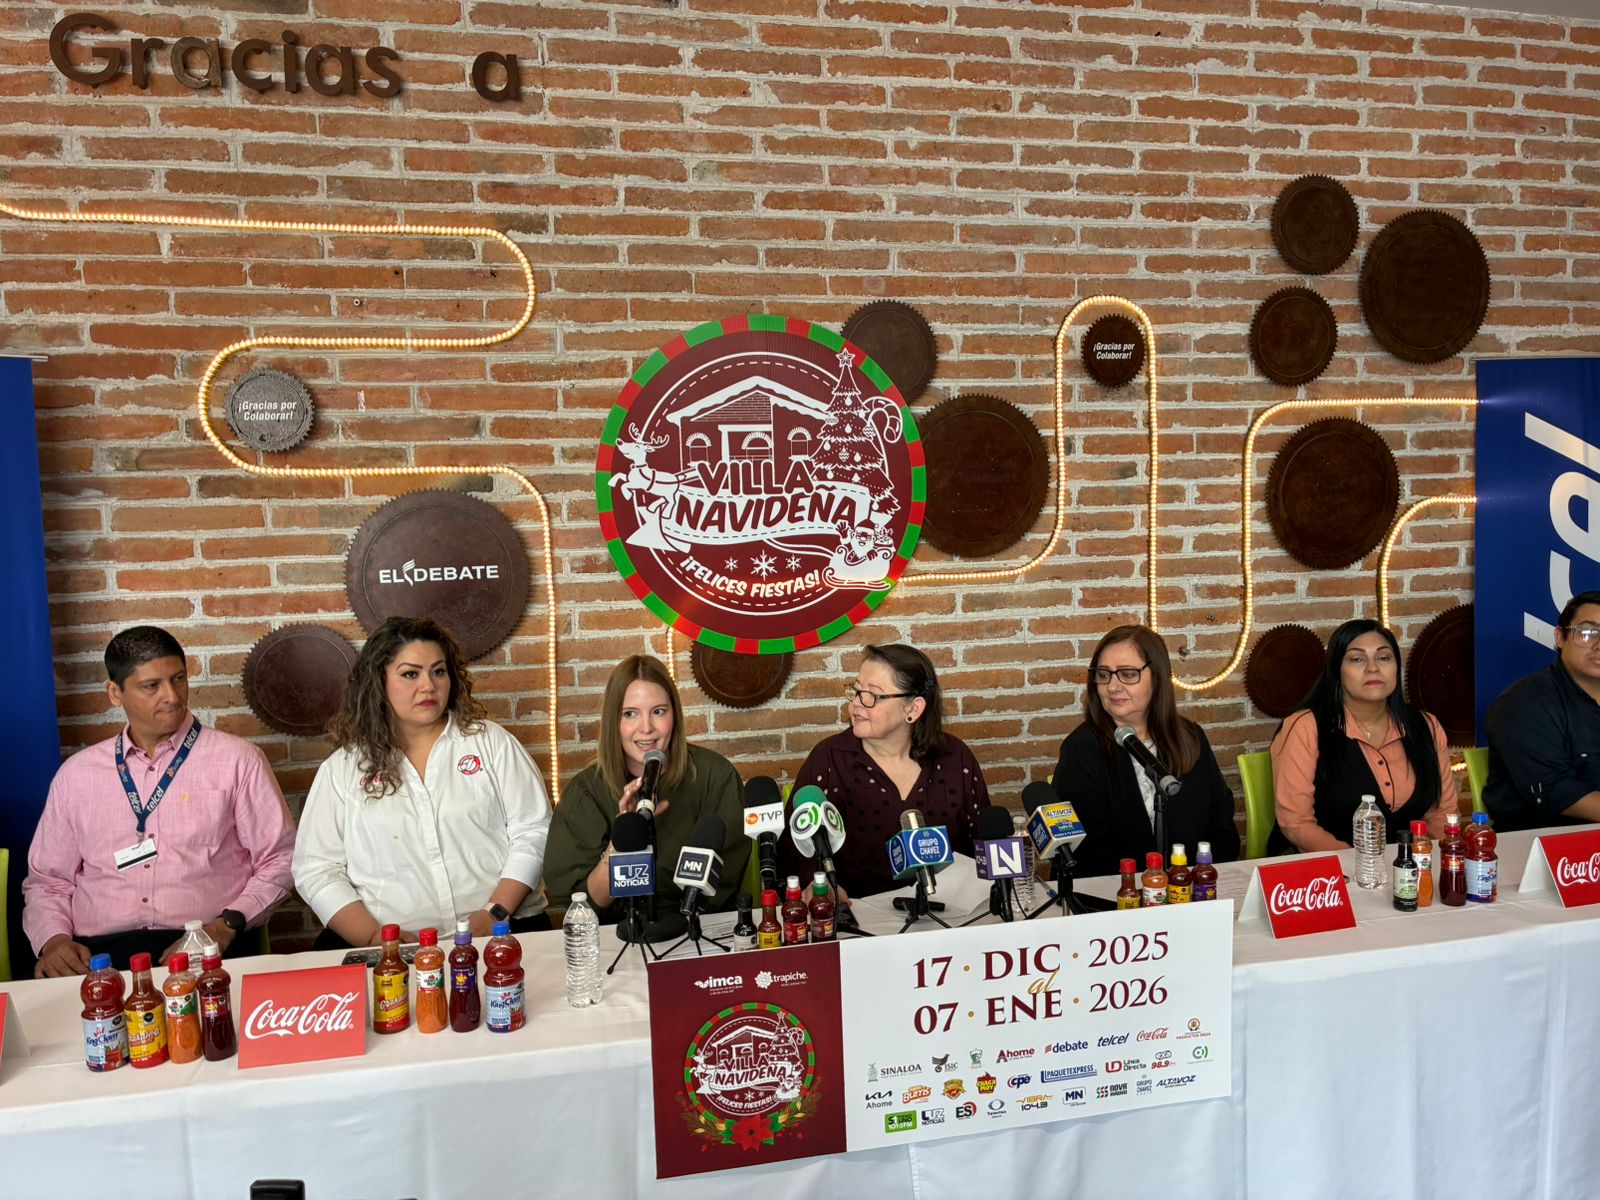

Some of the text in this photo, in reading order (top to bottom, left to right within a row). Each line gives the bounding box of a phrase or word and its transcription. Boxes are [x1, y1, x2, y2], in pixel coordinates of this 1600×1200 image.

[49, 12, 518, 100] Gracias a
[1093, 342, 1135, 352] ¡Gracias por
[1096, 351, 1132, 360] Colaborar!
[238, 400, 297, 412] ¡Gracias por
[244, 411, 294, 421] Colaborar!
[696, 460, 818, 496] VILLA
[675, 484, 858, 534] NAVIDEÑA
[379, 565, 499, 584] EL DEBATE
[680, 555, 820, 598] ¡FELICES FIESTAS!
[184, 728, 198, 749] telcel
[147, 786, 164, 812] telcel
[759, 810, 782, 822] TVP
[614, 864, 649, 881] LUZ
[683, 860, 702, 872] MN
[614, 879, 649, 888] NOTICIAS
[1270, 875, 1341, 915] Coca-Cola
[913, 931, 1169, 989] 17 DIC 2025
[709, 975, 742, 988] imca
[773, 971, 808, 983] trapiche
[1027, 968, 1060, 995] al
[914, 975, 1168, 1035] 07 ENE 2026
[244, 992, 359, 1040] Coca-Cola
[1052, 1040, 1088, 1053] debate
[1097, 1032, 1130, 1047] telcel
[996, 1048, 1035, 1063] Ahome
[723, 1055, 771, 1071] VILLA
[880, 1063, 922, 1075] SINALOA
[1123, 1063, 1147, 1072] Directa
[1151, 1060, 1169, 1070] 98.9
[714, 1063, 787, 1086] NAVIDEÑA
[1046, 1064, 1094, 1078] PAQUETEXPRESS
[1010, 1075, 1031, 1089] cpe
[1156, 1075, 1196, 1087] ALTAVOZ
[1065, 1090, 1083, 1101] MN
[866, 1100, 893, 1109] Ahome
[956, 1105, 972, 1118] ES
[1021, 1101, 1048, 1111] 104.3
